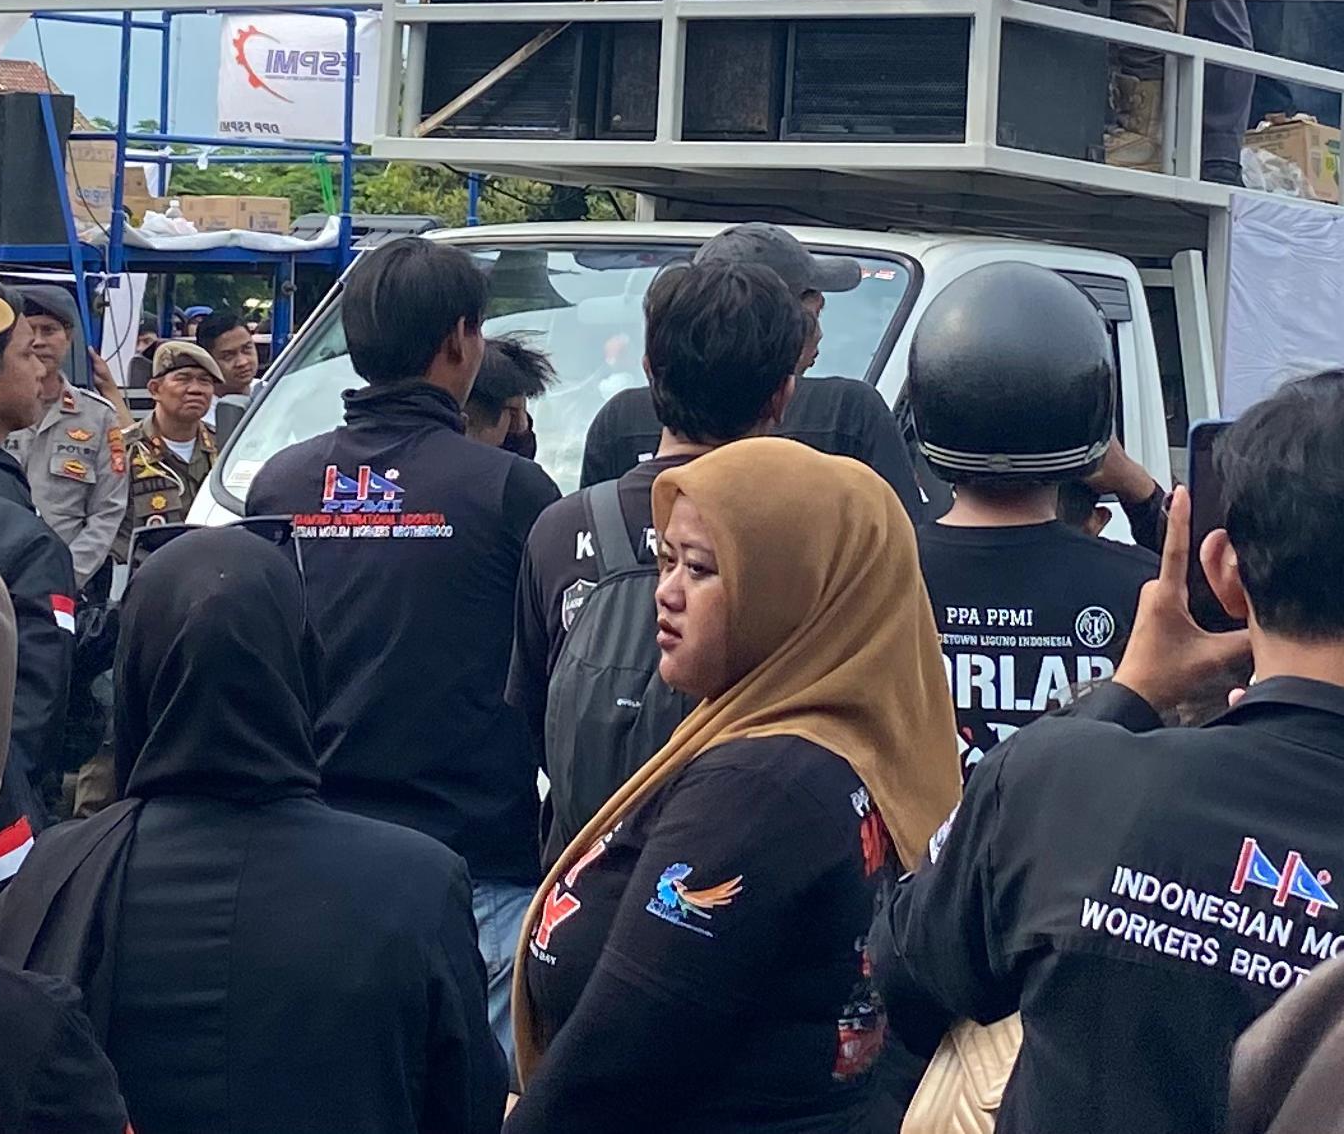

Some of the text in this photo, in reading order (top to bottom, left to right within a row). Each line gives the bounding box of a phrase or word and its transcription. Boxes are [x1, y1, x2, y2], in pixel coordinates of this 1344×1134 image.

[321, 499, 403, 513] PPMI
[946, 607, 1034, 627] PPA PPMI
[1018, 635, 1073, 648] INDONESIA
[1111, 865, 1294, 948] INDONESIAN
[1080, 897, 1312, 990] WORKERS BROT
